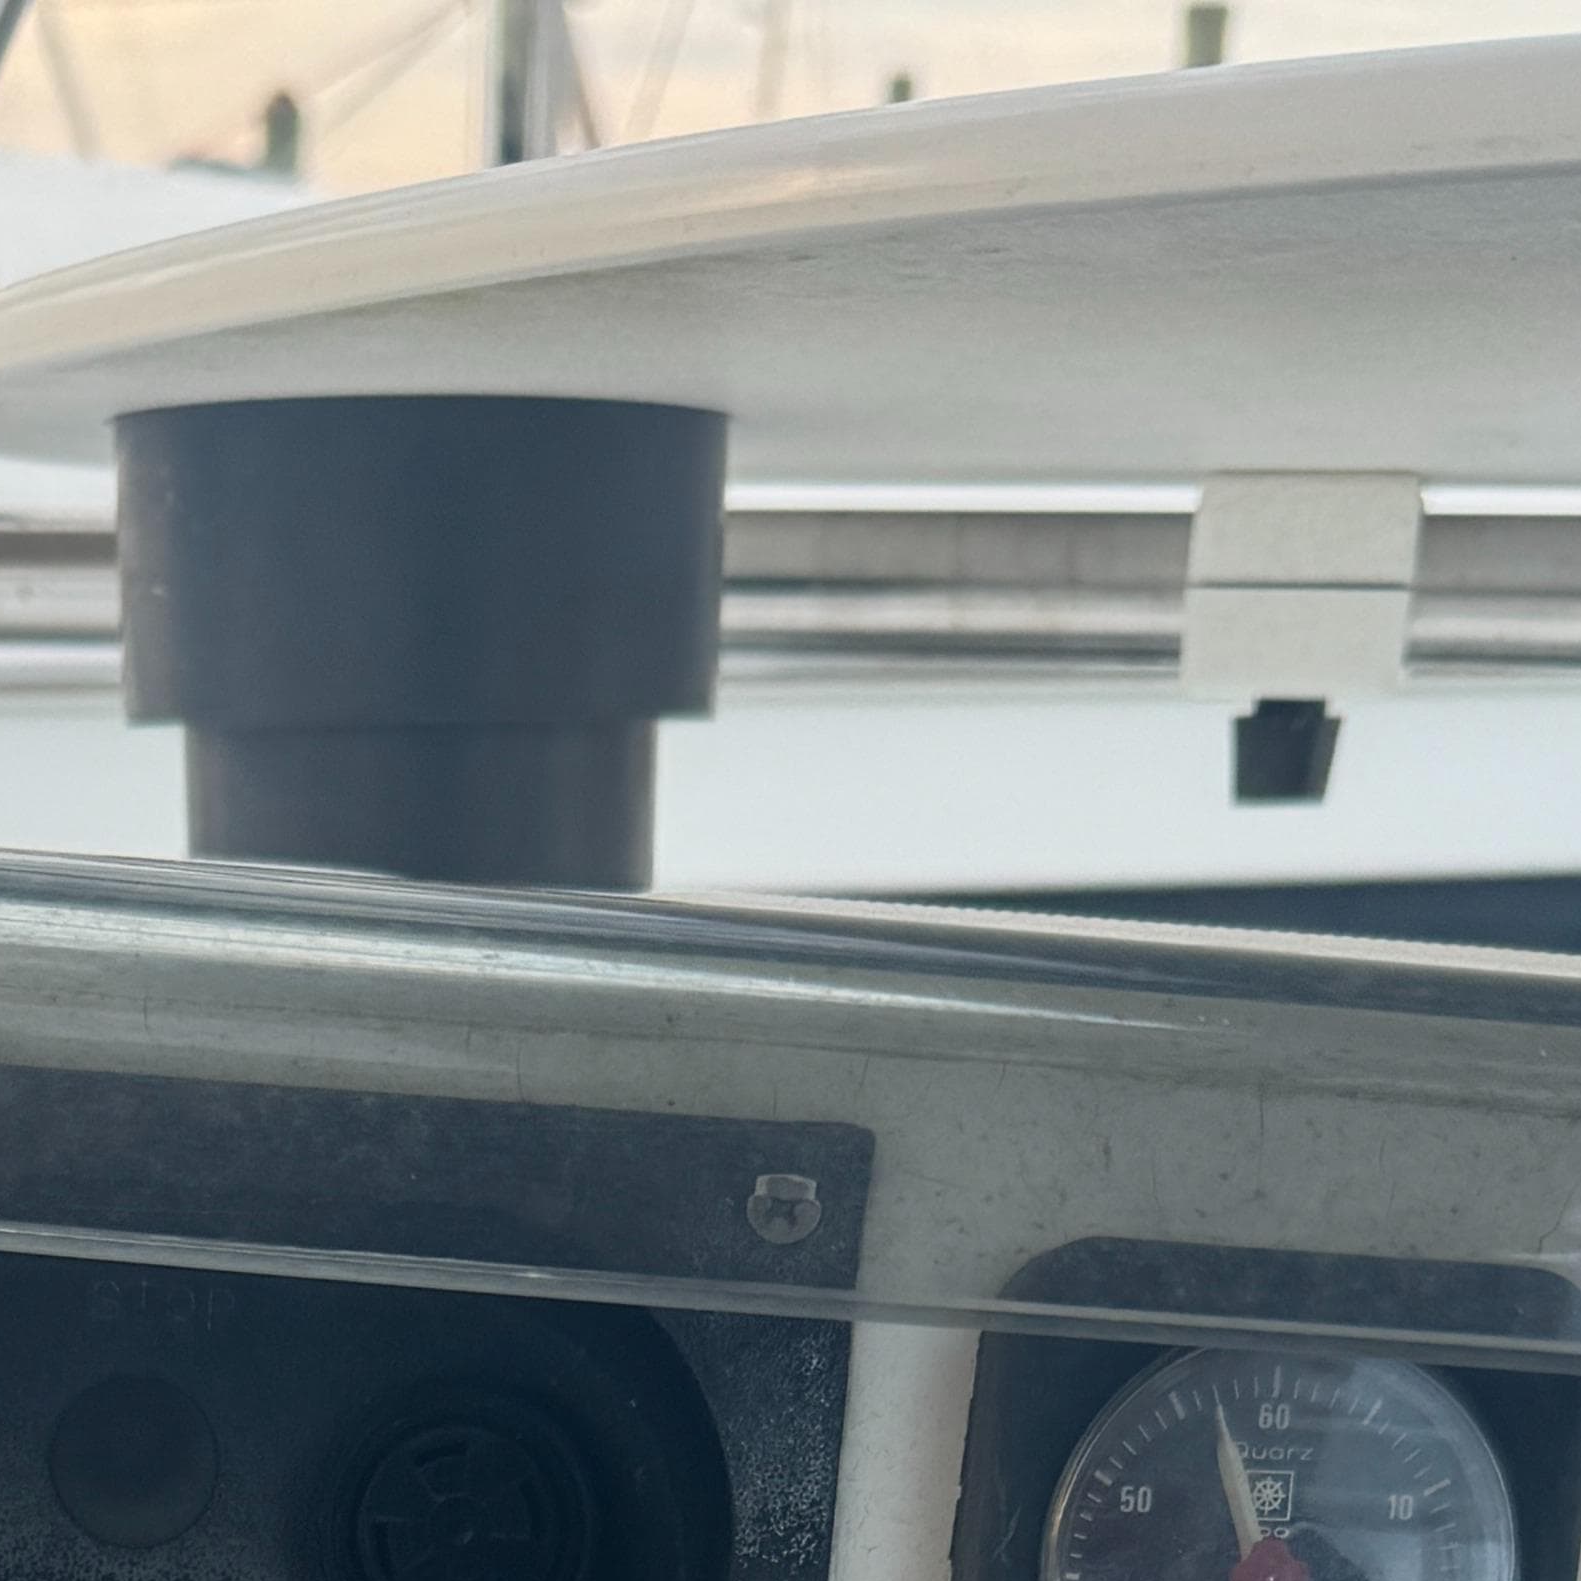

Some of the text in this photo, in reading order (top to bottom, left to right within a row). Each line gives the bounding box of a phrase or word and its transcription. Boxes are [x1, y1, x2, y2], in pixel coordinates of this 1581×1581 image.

[1258, 1404, 1290, 1430] 60
[1120, 1486, 1153, 1513] 50
[1388, 1495, 1414, 1520] 10
